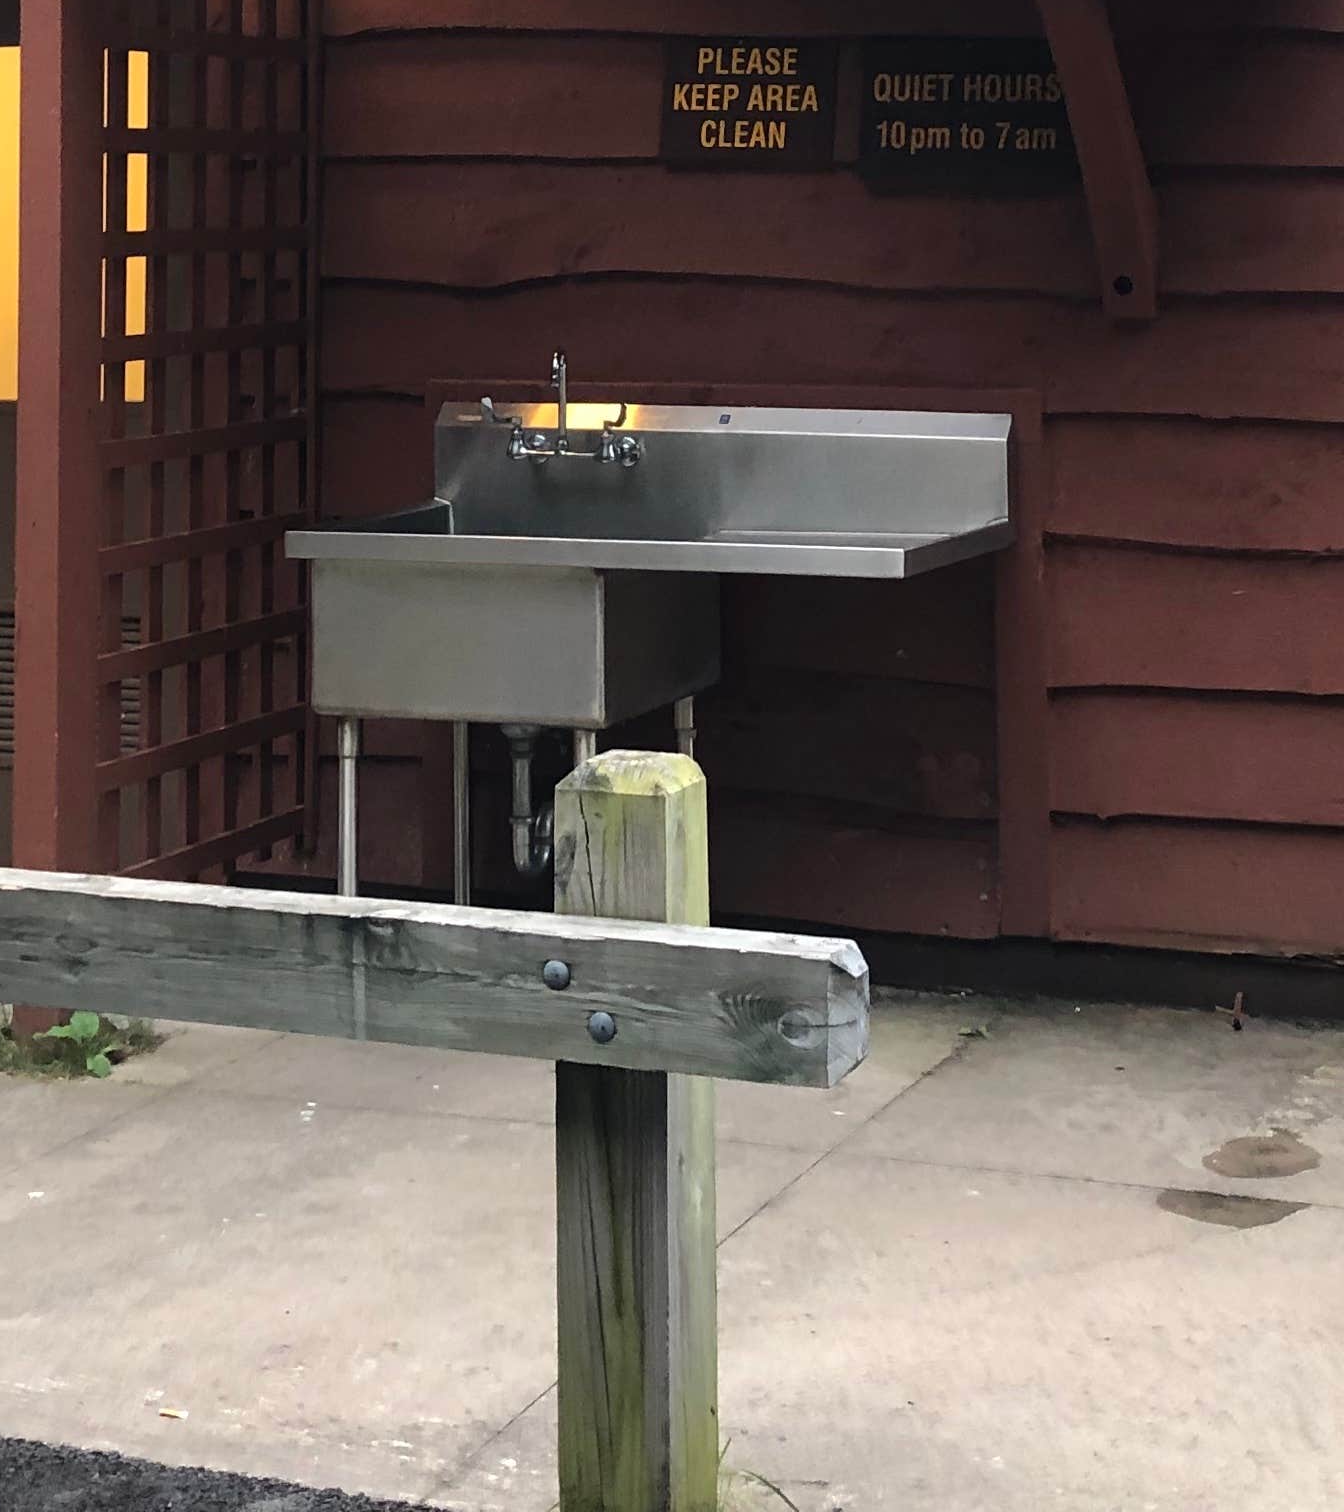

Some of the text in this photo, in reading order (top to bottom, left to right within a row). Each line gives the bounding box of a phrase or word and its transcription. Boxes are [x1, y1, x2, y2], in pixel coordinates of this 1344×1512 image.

[697, 47, 799, 76] PLEASE
[672, 83, 819, 112] KEEP AREA
[872, 73, 1061, 103] QUIET HOURS
[700, 119, 787, 149] CLEAN
[960, 122, 985, 150] to
